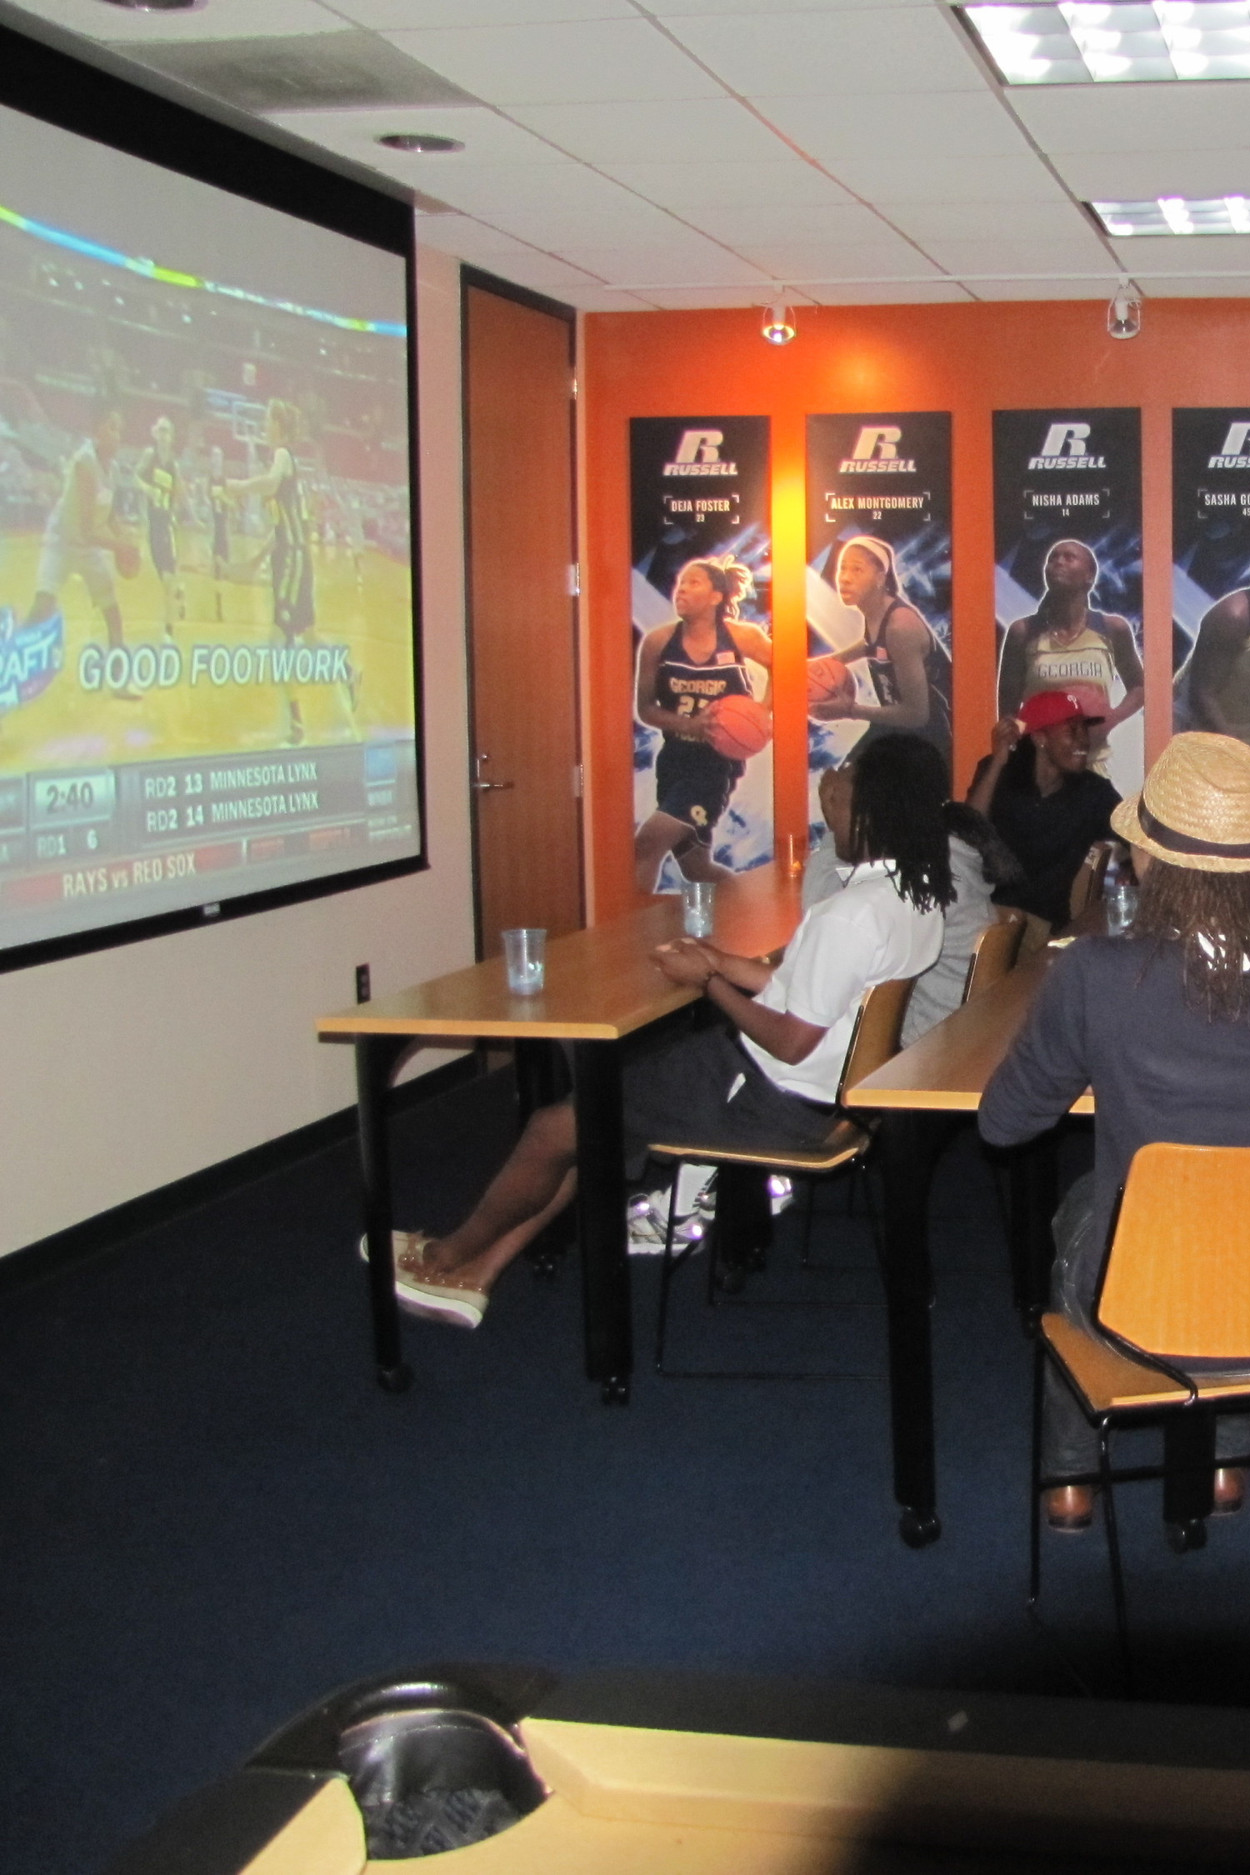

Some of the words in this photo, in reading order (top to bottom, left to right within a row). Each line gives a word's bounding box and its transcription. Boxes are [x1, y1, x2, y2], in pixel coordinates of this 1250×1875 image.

[663, 463, 739, 476] RUSSELL
[839, 460, 917, 473] RUSSELL
[1027, 457, 1107, 470] RUSSELL
[671, 500, 693, 512] DEJA
[696, 500, 730, 512] FOSTER
[831, 498, 854, 510] ALEX
[858, 498, 925, 510] MONTGOMERY
[1032, 495, 1062, 507] NISHA
[1066, 495, 1100, 506] ADAMS
[1204, 494, 1237, 506] SASHA
[1062, 509, 1070, 517] 14
[79, 646, 182, 690] GOOD
[191, 646, 350, 686] FOOTWORK
[145, 775, 178, 799] RD2
[184, 772, 203, 795] 13
[210, 764, 286, 791] MINNESOTA
[287, 761, 319, 783] LYNX
[46, 781, 94, 814] 2:40
[146, 808, 178, 832] RD2
[186, 804, 204, 828] 14
[211, 794, 288, 823] MINNESOTA
[288, 790, 320, 813] LYNX
[86, 828, 99, 850] 6
[62, 867, 108, 898] RAYS
[133, 857, 163, 886] RED
[166, 851, 197, 880] SOX
